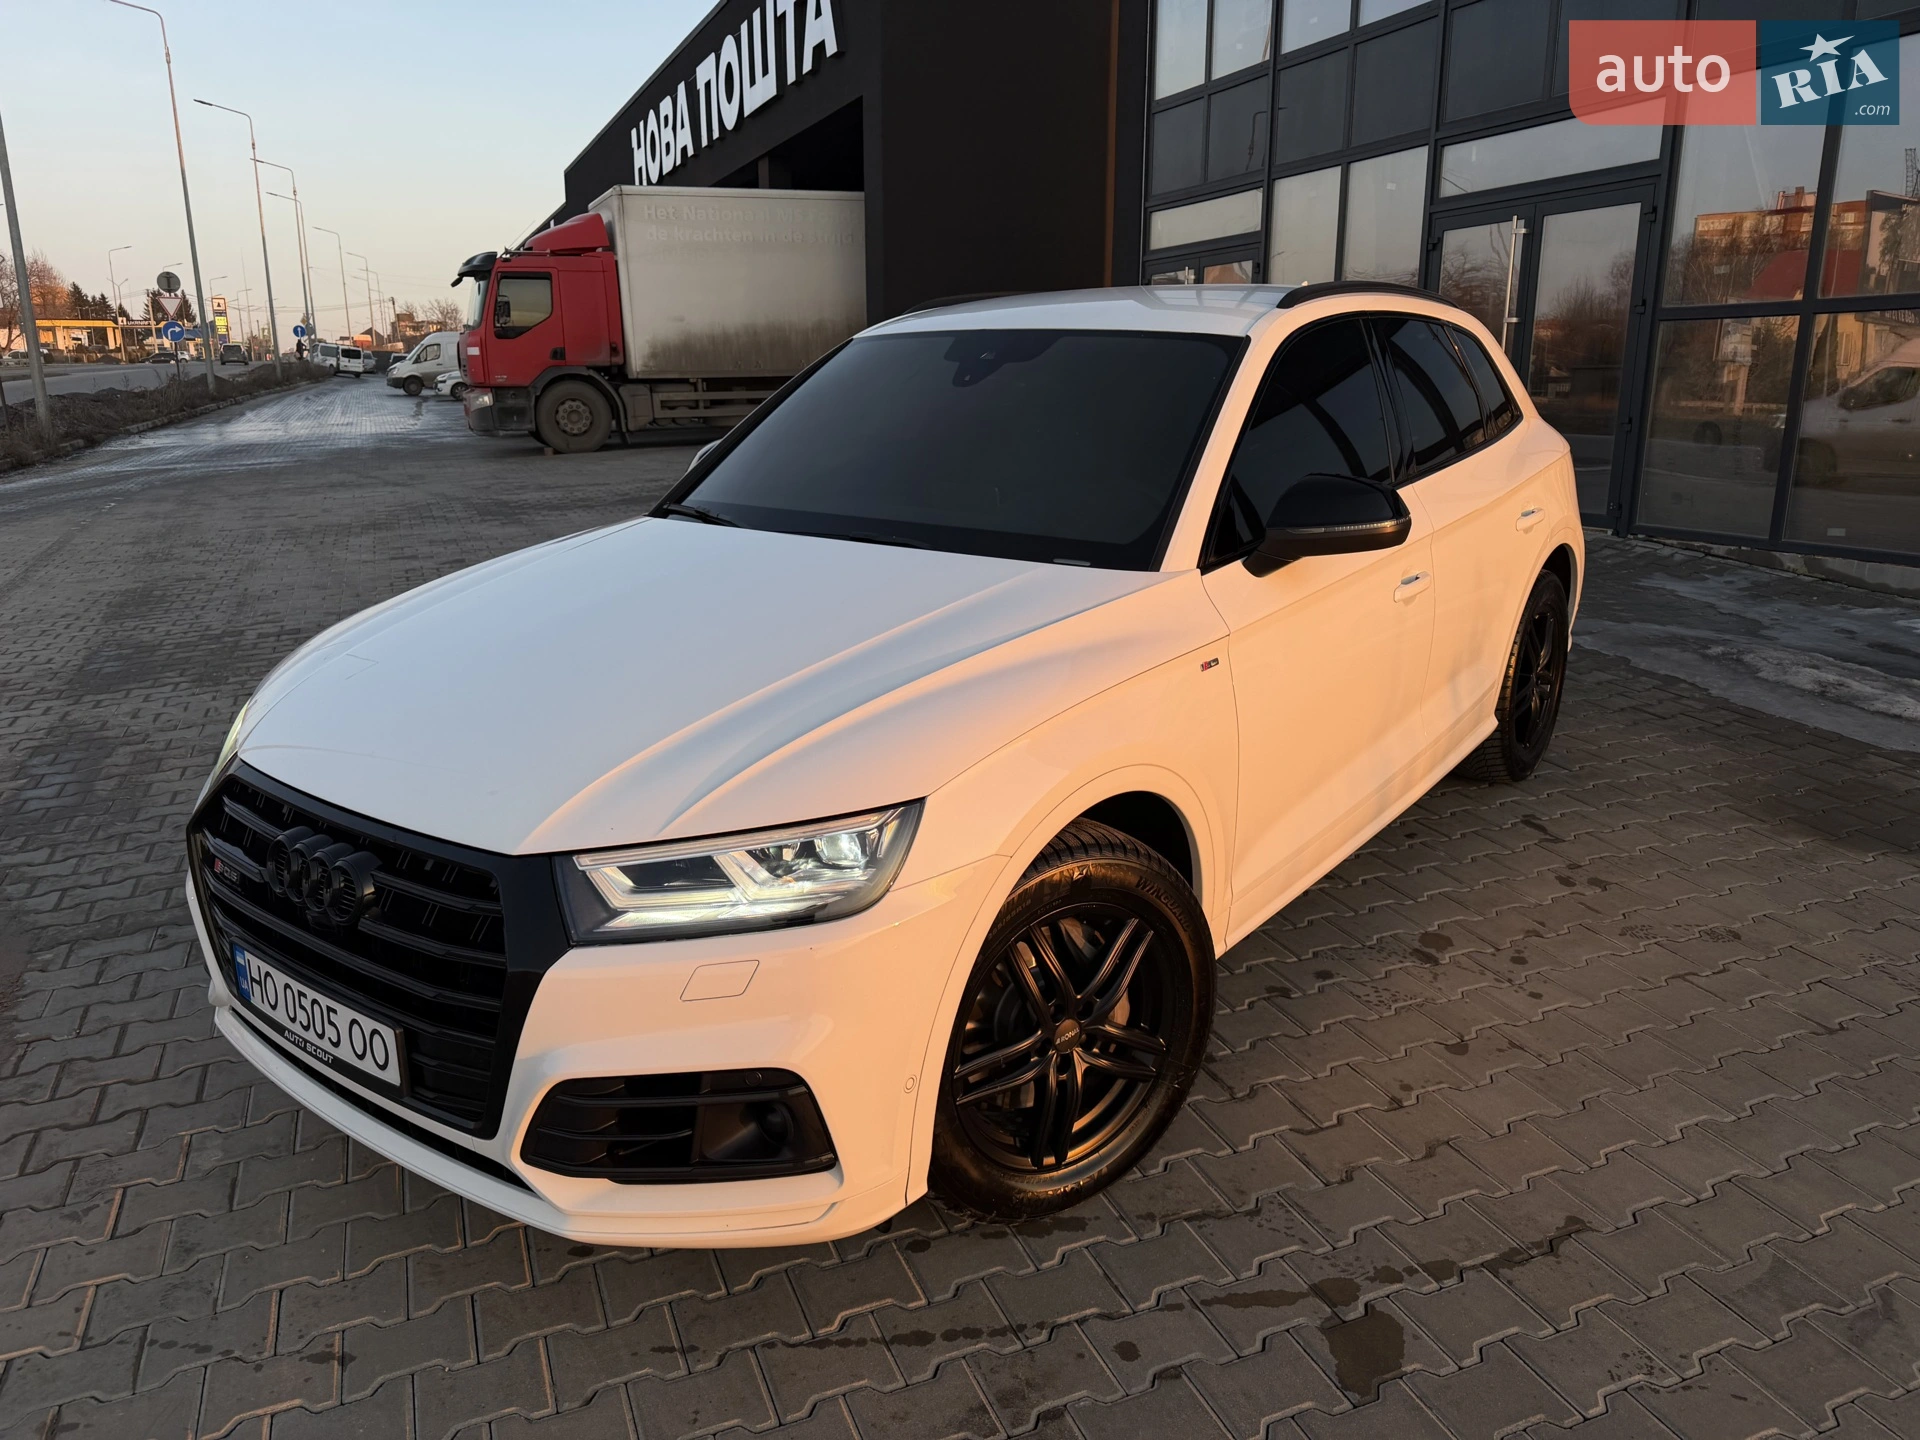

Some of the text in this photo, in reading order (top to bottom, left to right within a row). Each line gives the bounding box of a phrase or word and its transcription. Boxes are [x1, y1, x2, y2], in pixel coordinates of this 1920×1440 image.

[631, 0, 838, 186] НОВА ПОШТА
[247, 958, 278, 1011] HO
[284, 983, 341, 1048] 0505
[284, 1030, 333, 1064] AUTO SCOUT
